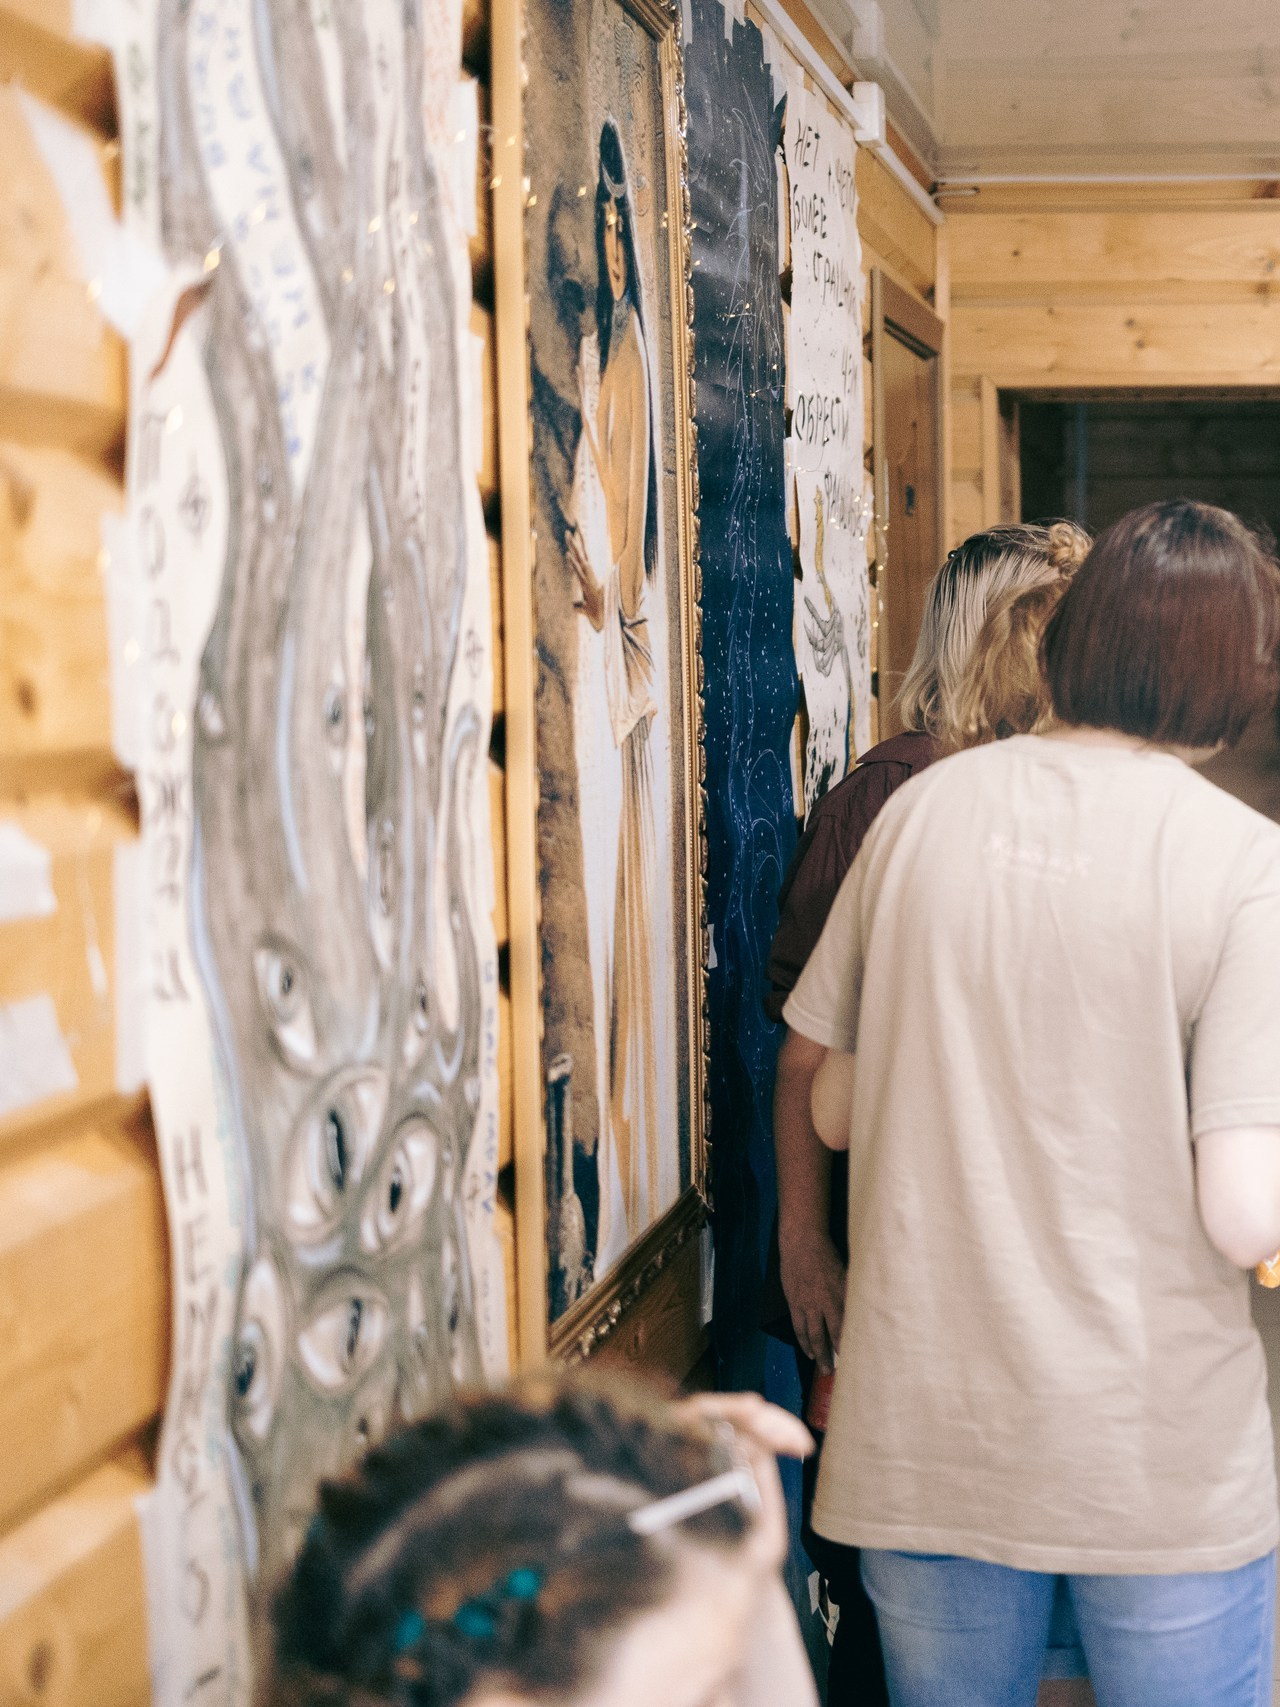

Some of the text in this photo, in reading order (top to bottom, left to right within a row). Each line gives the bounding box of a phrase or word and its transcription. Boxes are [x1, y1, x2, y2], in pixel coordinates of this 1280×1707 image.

[793, 118, 821, 172] НЕТ
[792, 184, 828, 239] БОЛЕЕ
[795, 392, 850, 446] ОБРЕСТИ
